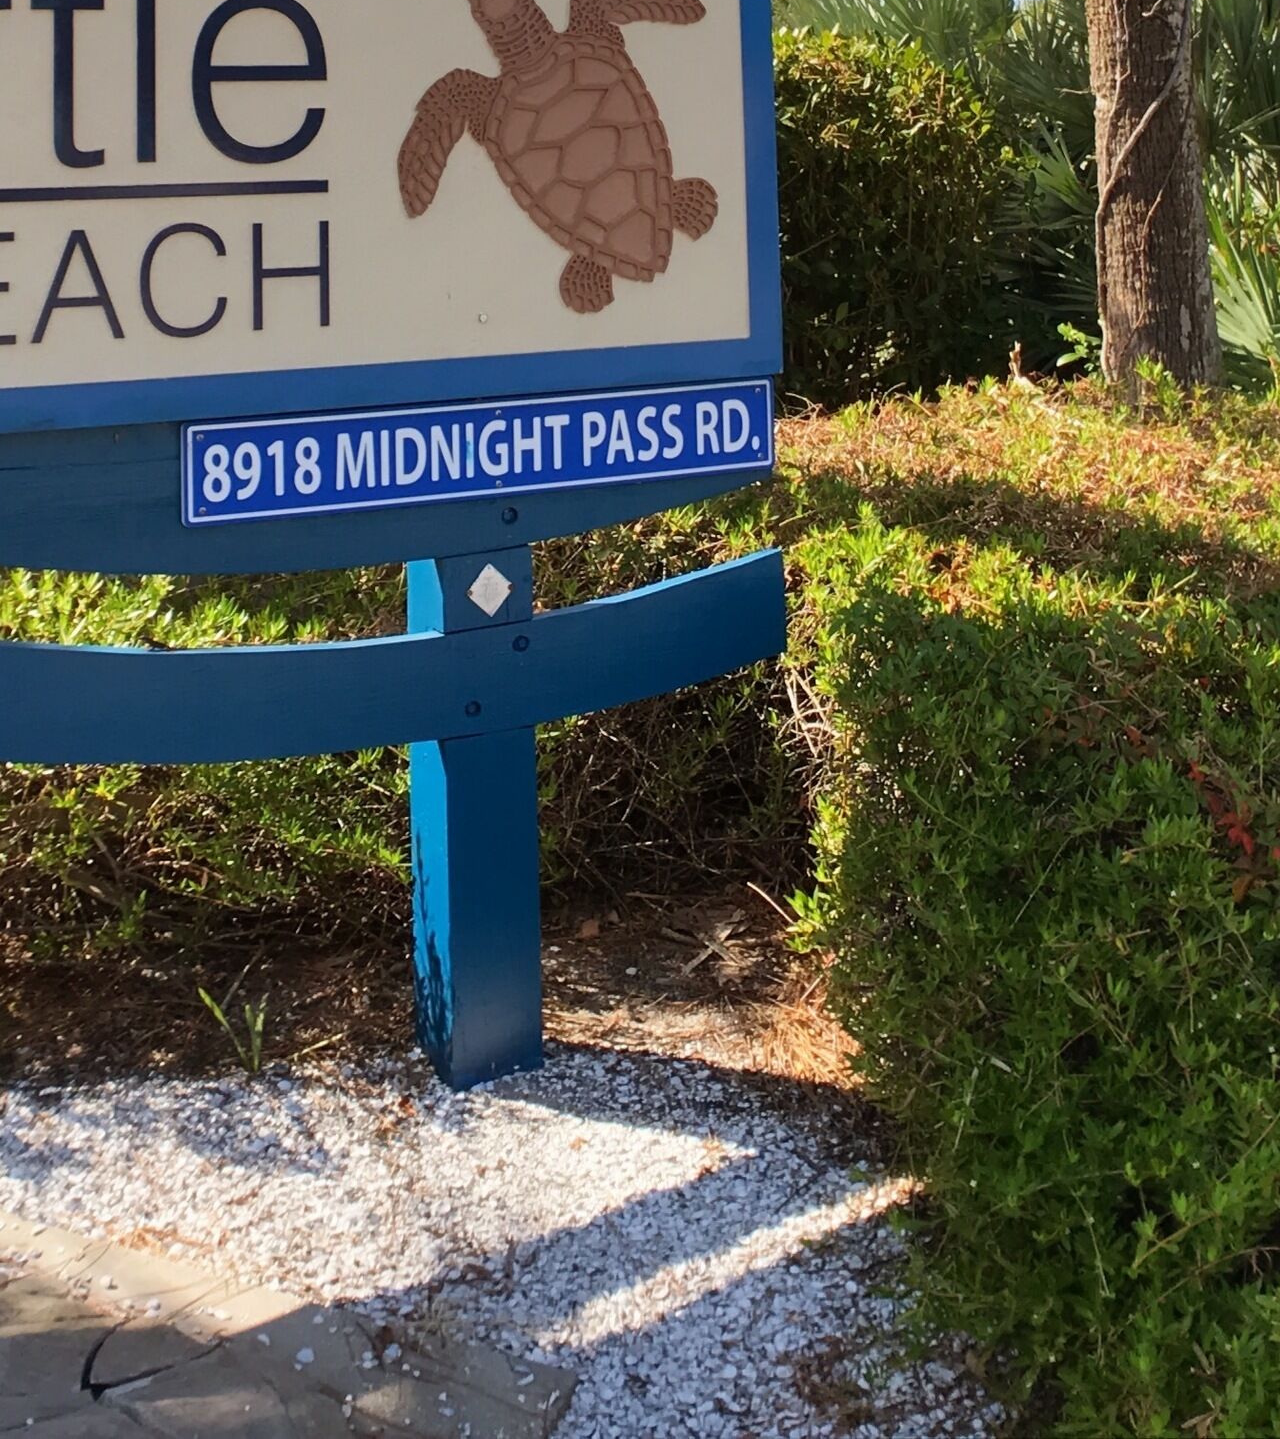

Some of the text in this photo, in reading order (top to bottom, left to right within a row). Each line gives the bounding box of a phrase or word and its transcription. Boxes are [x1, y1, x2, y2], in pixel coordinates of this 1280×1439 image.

[202, 398, 761, 503] 8918 MIDNIGHT PASS RD.
